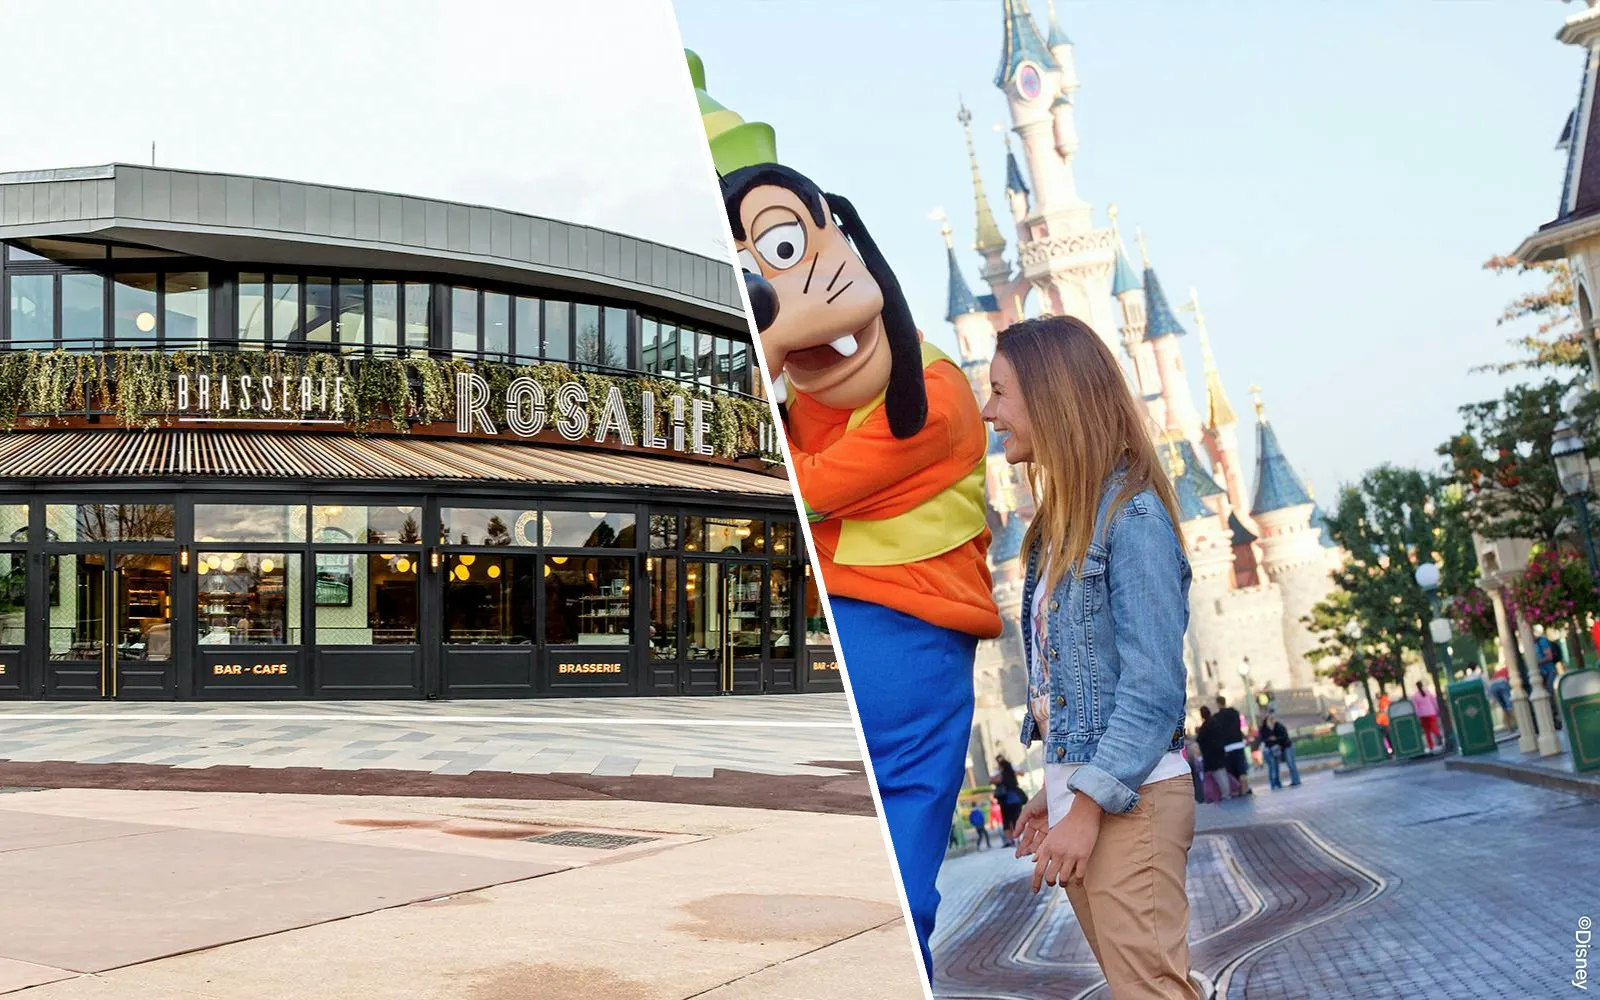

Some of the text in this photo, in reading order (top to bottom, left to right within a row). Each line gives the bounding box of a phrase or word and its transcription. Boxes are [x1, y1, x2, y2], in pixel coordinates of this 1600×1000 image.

[178, 374, 344, 411] BRASSERIE
[456, 372, 714, 456] ROSALIE
[213, 664, 242, 675] BAR
[558, 663, 621, 673] BRASSERIE
[813, 662, 826, 670] BAR
